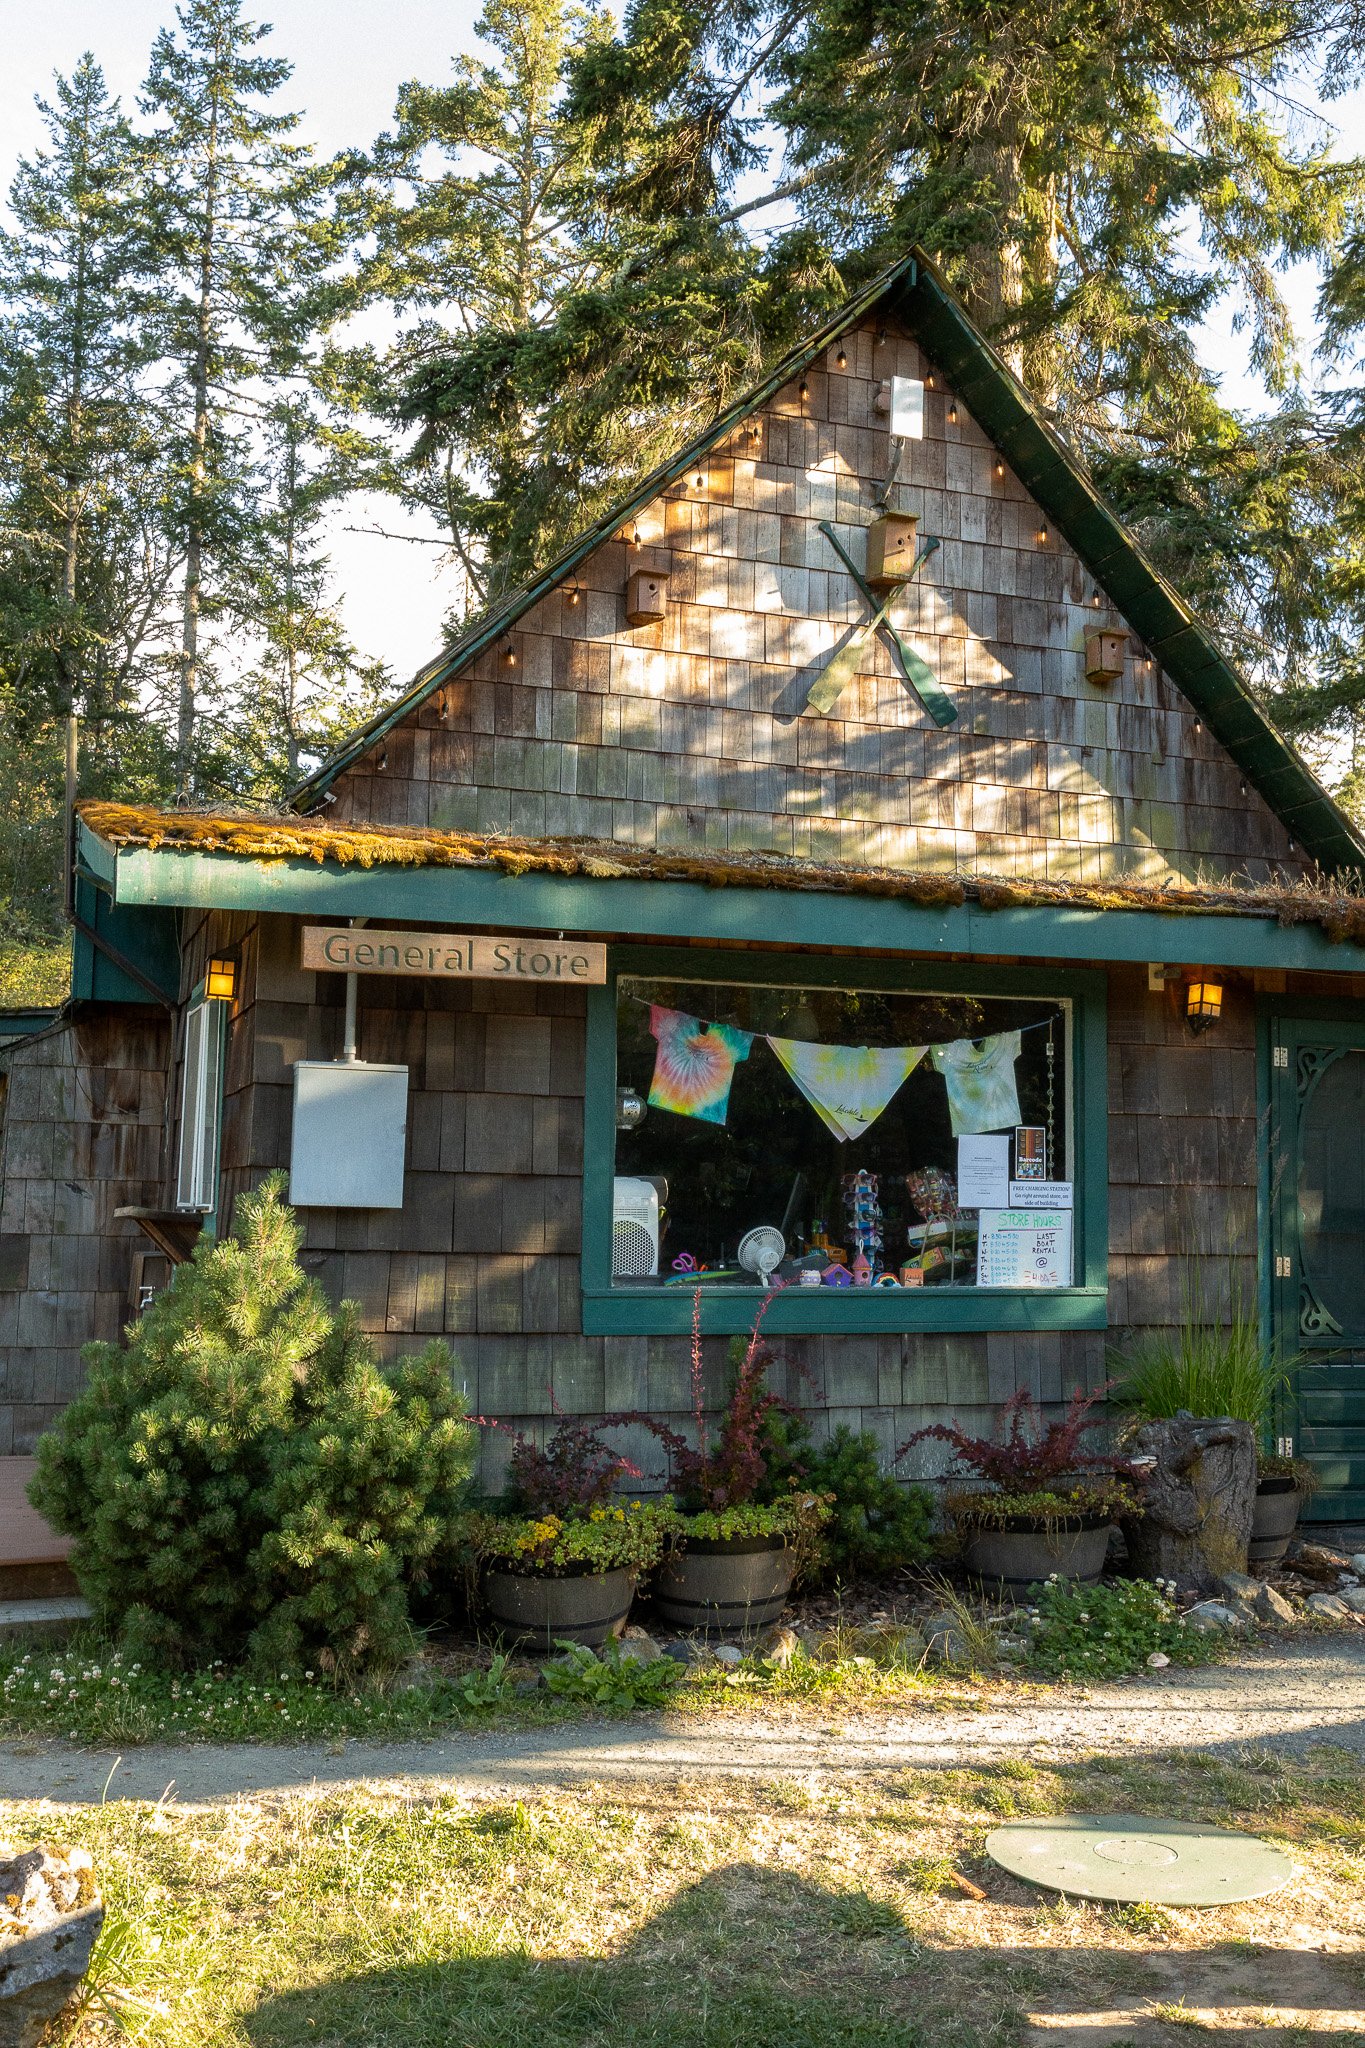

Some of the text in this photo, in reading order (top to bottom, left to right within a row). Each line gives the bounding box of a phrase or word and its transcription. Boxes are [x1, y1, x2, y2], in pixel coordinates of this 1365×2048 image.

[323, 934, 590, 977] General Store
[998, 1213, 1062, 1228] STORE HOURS
[1036, 1257, 1047, 1268] @
